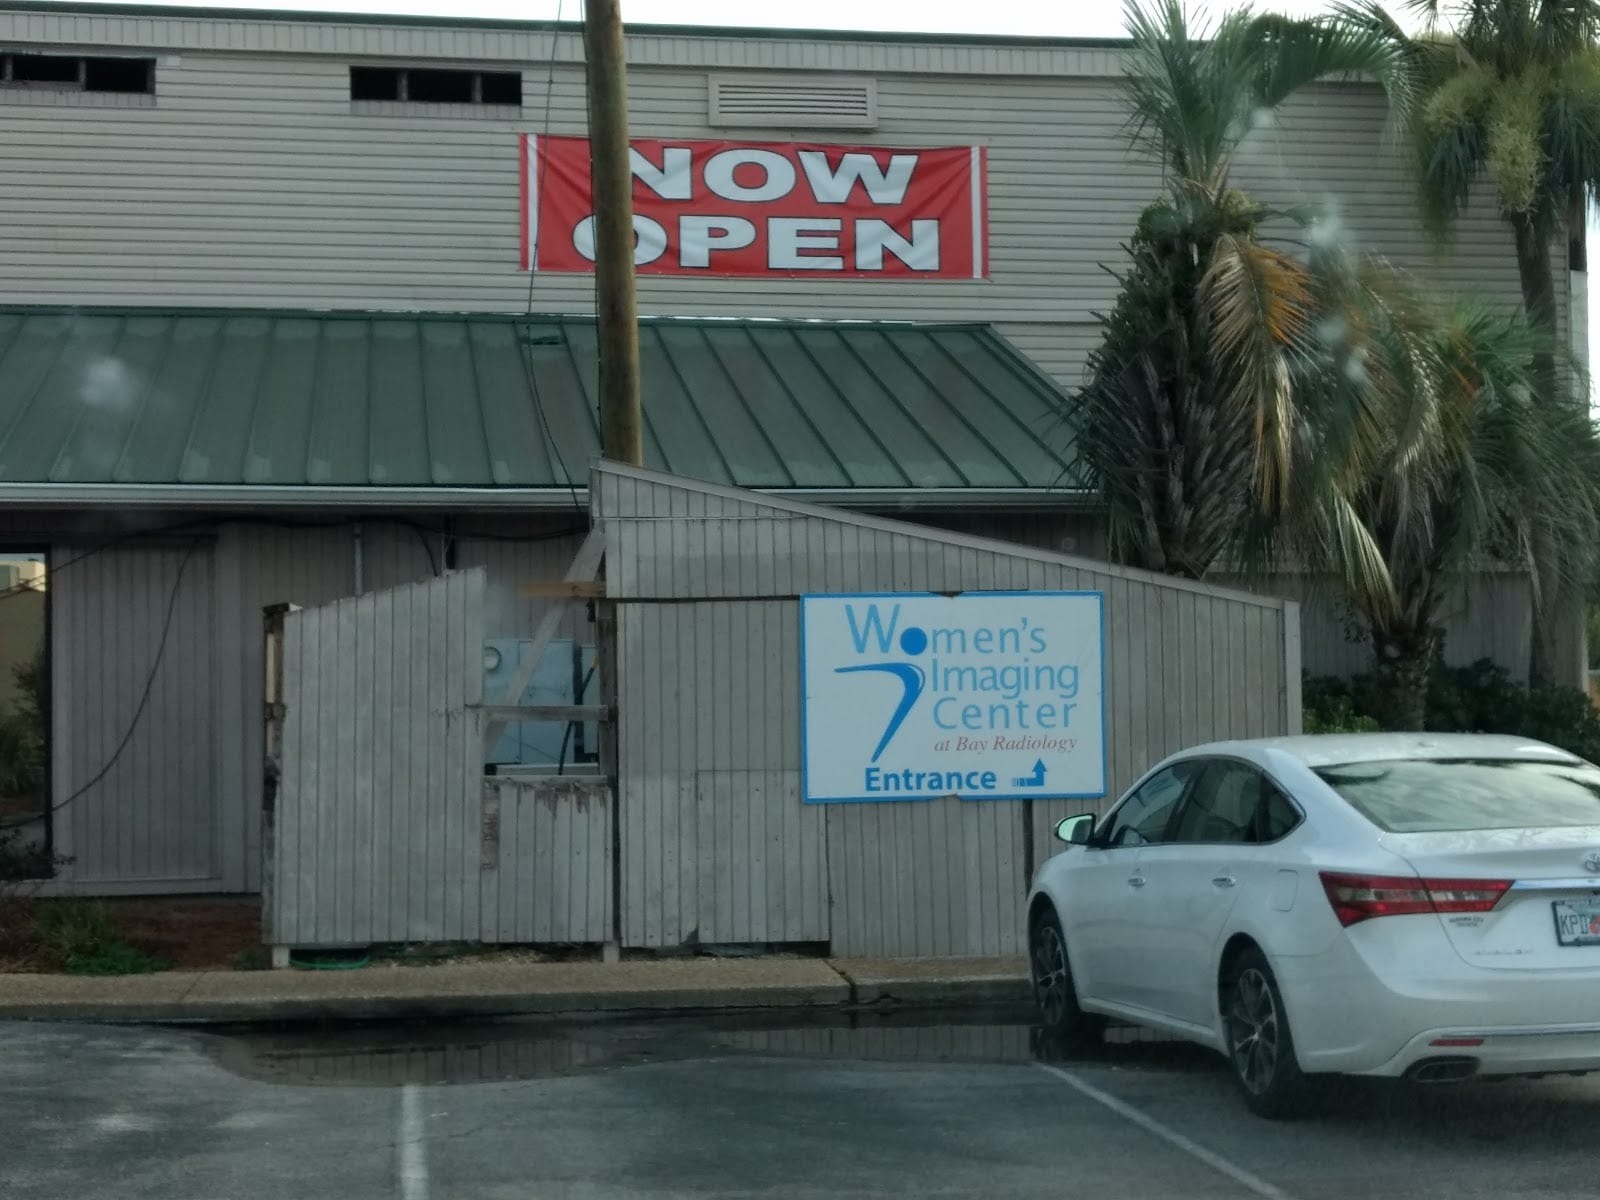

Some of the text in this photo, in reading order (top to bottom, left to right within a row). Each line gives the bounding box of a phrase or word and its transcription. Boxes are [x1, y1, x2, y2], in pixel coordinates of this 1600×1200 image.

[629, 147, 918, 204] NOW
[572, 213, 941, 271] OPEN
[845, 603, 1046, 656] Women's
[932, 658, 1079, 699] Imaging
[932, 697, 1078, 730] Center
[934, 735, 1079, 755] at Bay Radiology
[865, 767, 997, 792] Entrance
